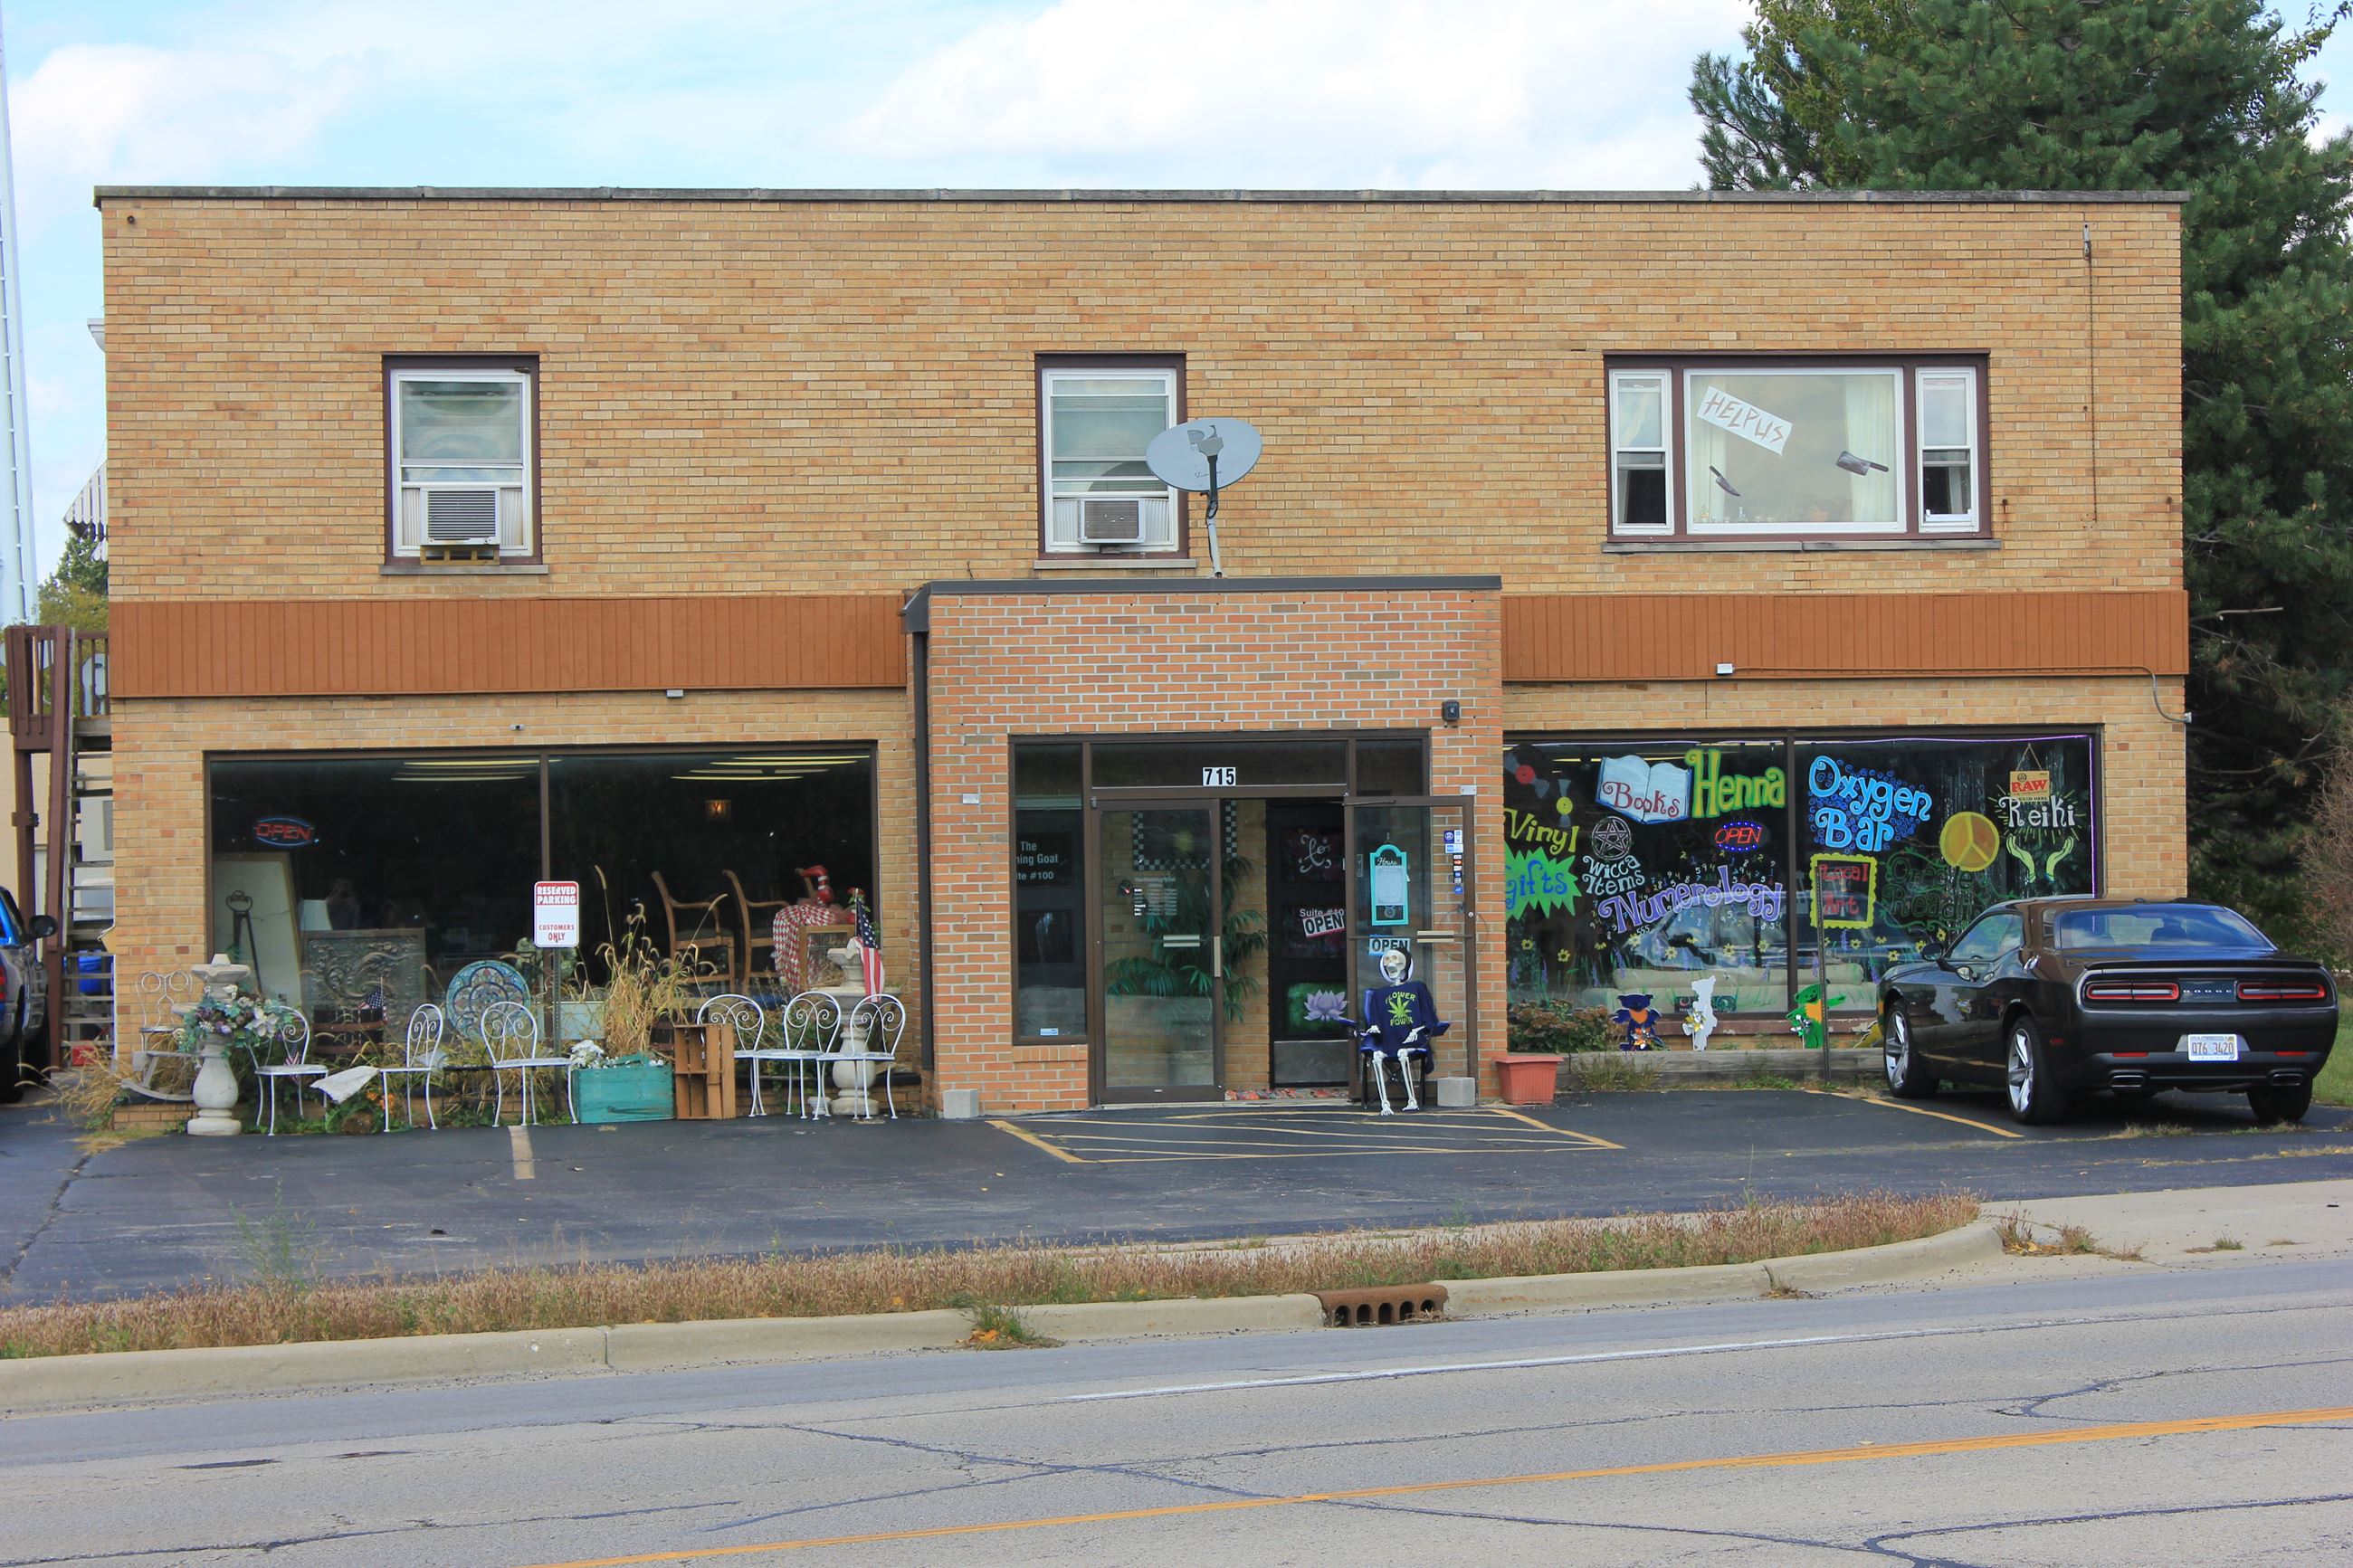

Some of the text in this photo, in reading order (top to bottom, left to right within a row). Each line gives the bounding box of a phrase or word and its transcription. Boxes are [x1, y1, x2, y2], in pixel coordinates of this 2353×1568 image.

[1205, 767, 1235, 785] 715
[1683, 748, 1786, 818] Henna
[1809, 755, 1932, 822] Oxygen
[2011, 779, 2048, 793] RAW
[1602, 781, 1681, 818] Books
[256, 822, 310, 840] OPEN
[1503, 808, 1580, 855] Vinyl
[1714, 827, 1762, 844] OPEN
[1815, 807, 1894, 852] Bar
[1020, 841, 1037, 851] The
[1015, 853, 1058, 866] ning Goat
[1582, 855, 1641, 879] Wicca
[1030, 871, 1054, 880] #100
[1819, 863, 1869, 882] Local
[537, 886, 576, 895] RESERVED
[1582, 870, 1645, 896] Items
[537, 896, 576, 904] PARKING
[1598, 865, 1783, 934] Numerology
[1823, 891, 1860, 916] Art
[1300, 908, 1323, 917] Suite
[1305, 913, 1343, 935] OPEN
[1636, 925, 1651, 935] 555
[548, 933, 566, 941] ONLY
[1372, 939, 1408, 952] OPEN
